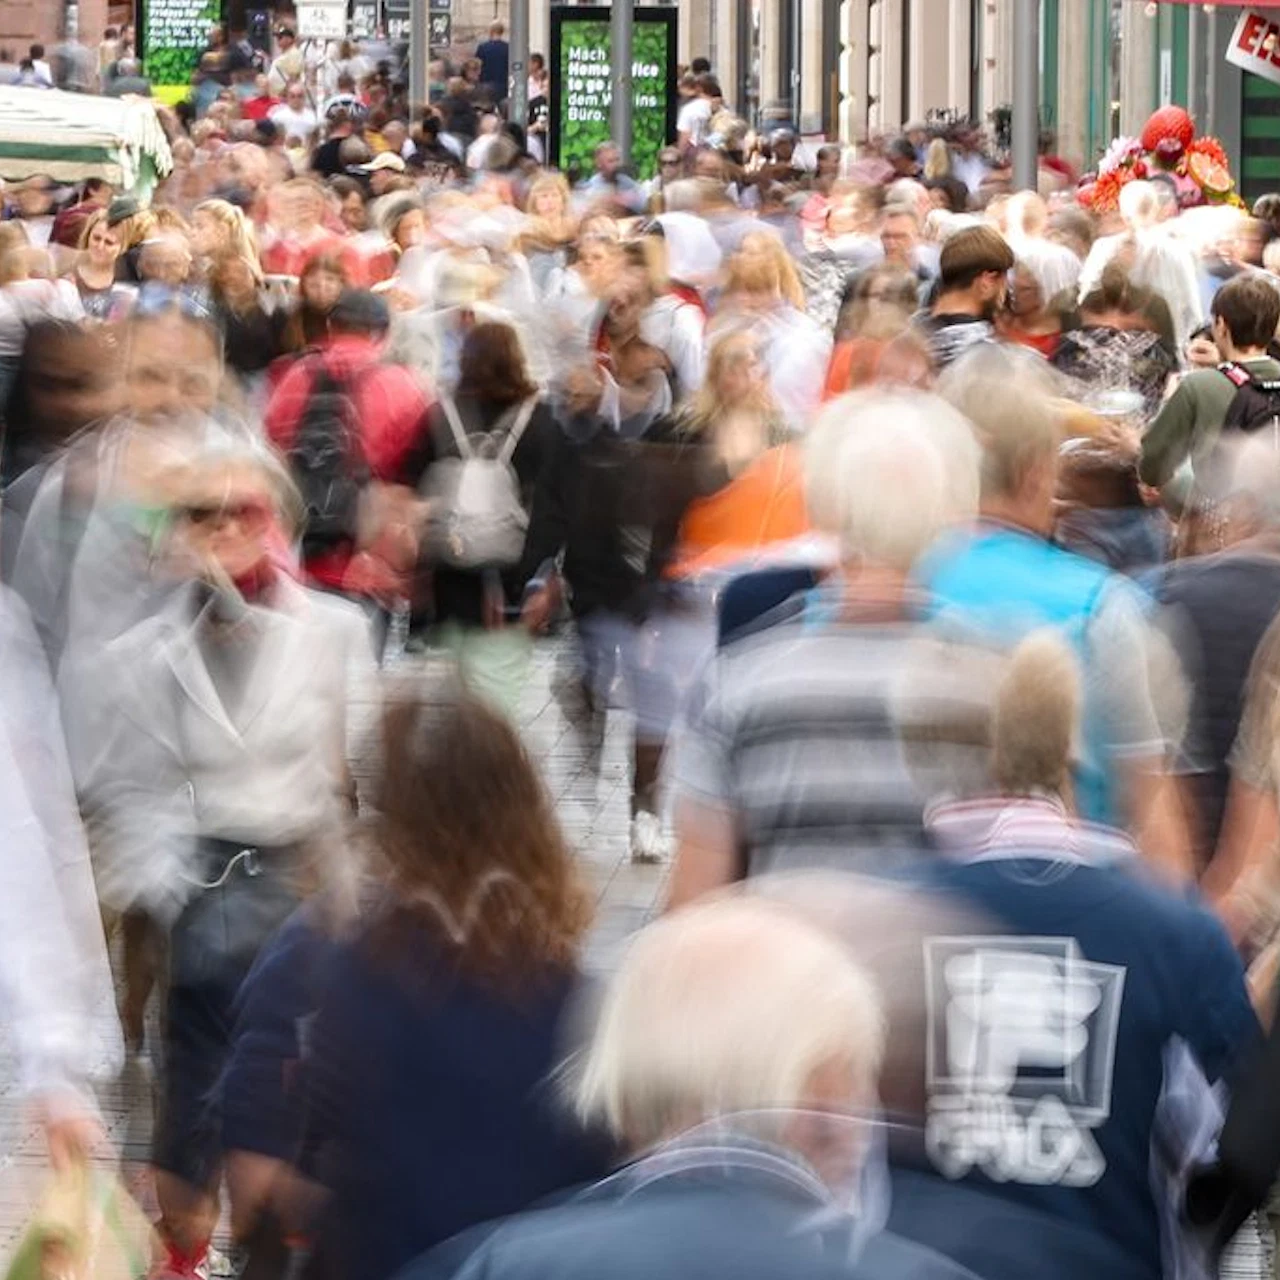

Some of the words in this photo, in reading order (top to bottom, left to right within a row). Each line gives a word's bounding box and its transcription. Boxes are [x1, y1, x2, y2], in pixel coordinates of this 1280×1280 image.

[569, 46, 606, 61] Mach
[568, 62, 610, 77] Home
[631, 62, 659, 78] fice
[568, 93, 599, 107] dem
[568, 106, 606, 122] Büro.
